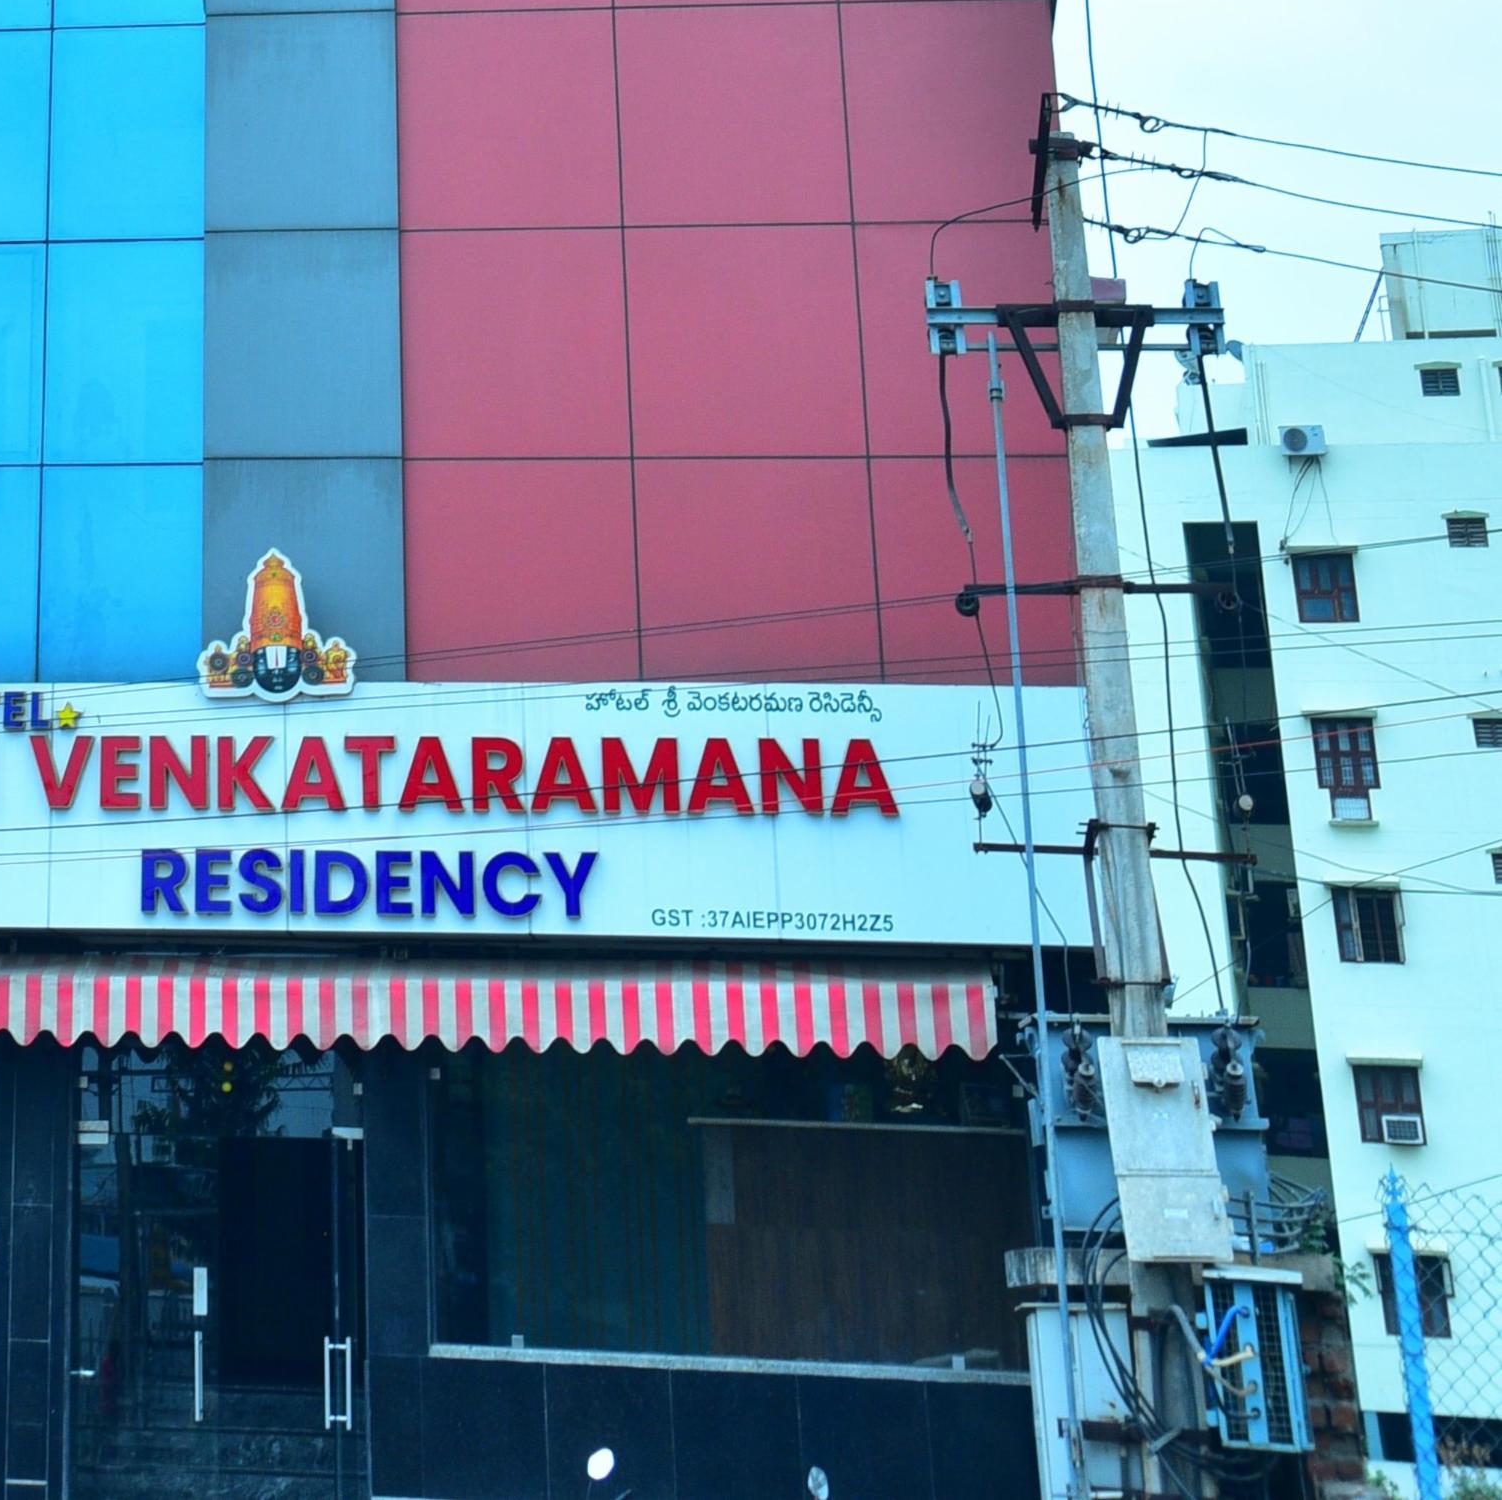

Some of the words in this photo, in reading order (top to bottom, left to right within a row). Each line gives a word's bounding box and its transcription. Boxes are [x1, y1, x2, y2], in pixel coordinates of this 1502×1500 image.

[31, 734, 899, 817] VENKATARAMANA
[140, 848, 600, 919] RESIDENCY
[651, 908, 694, 927] GST
